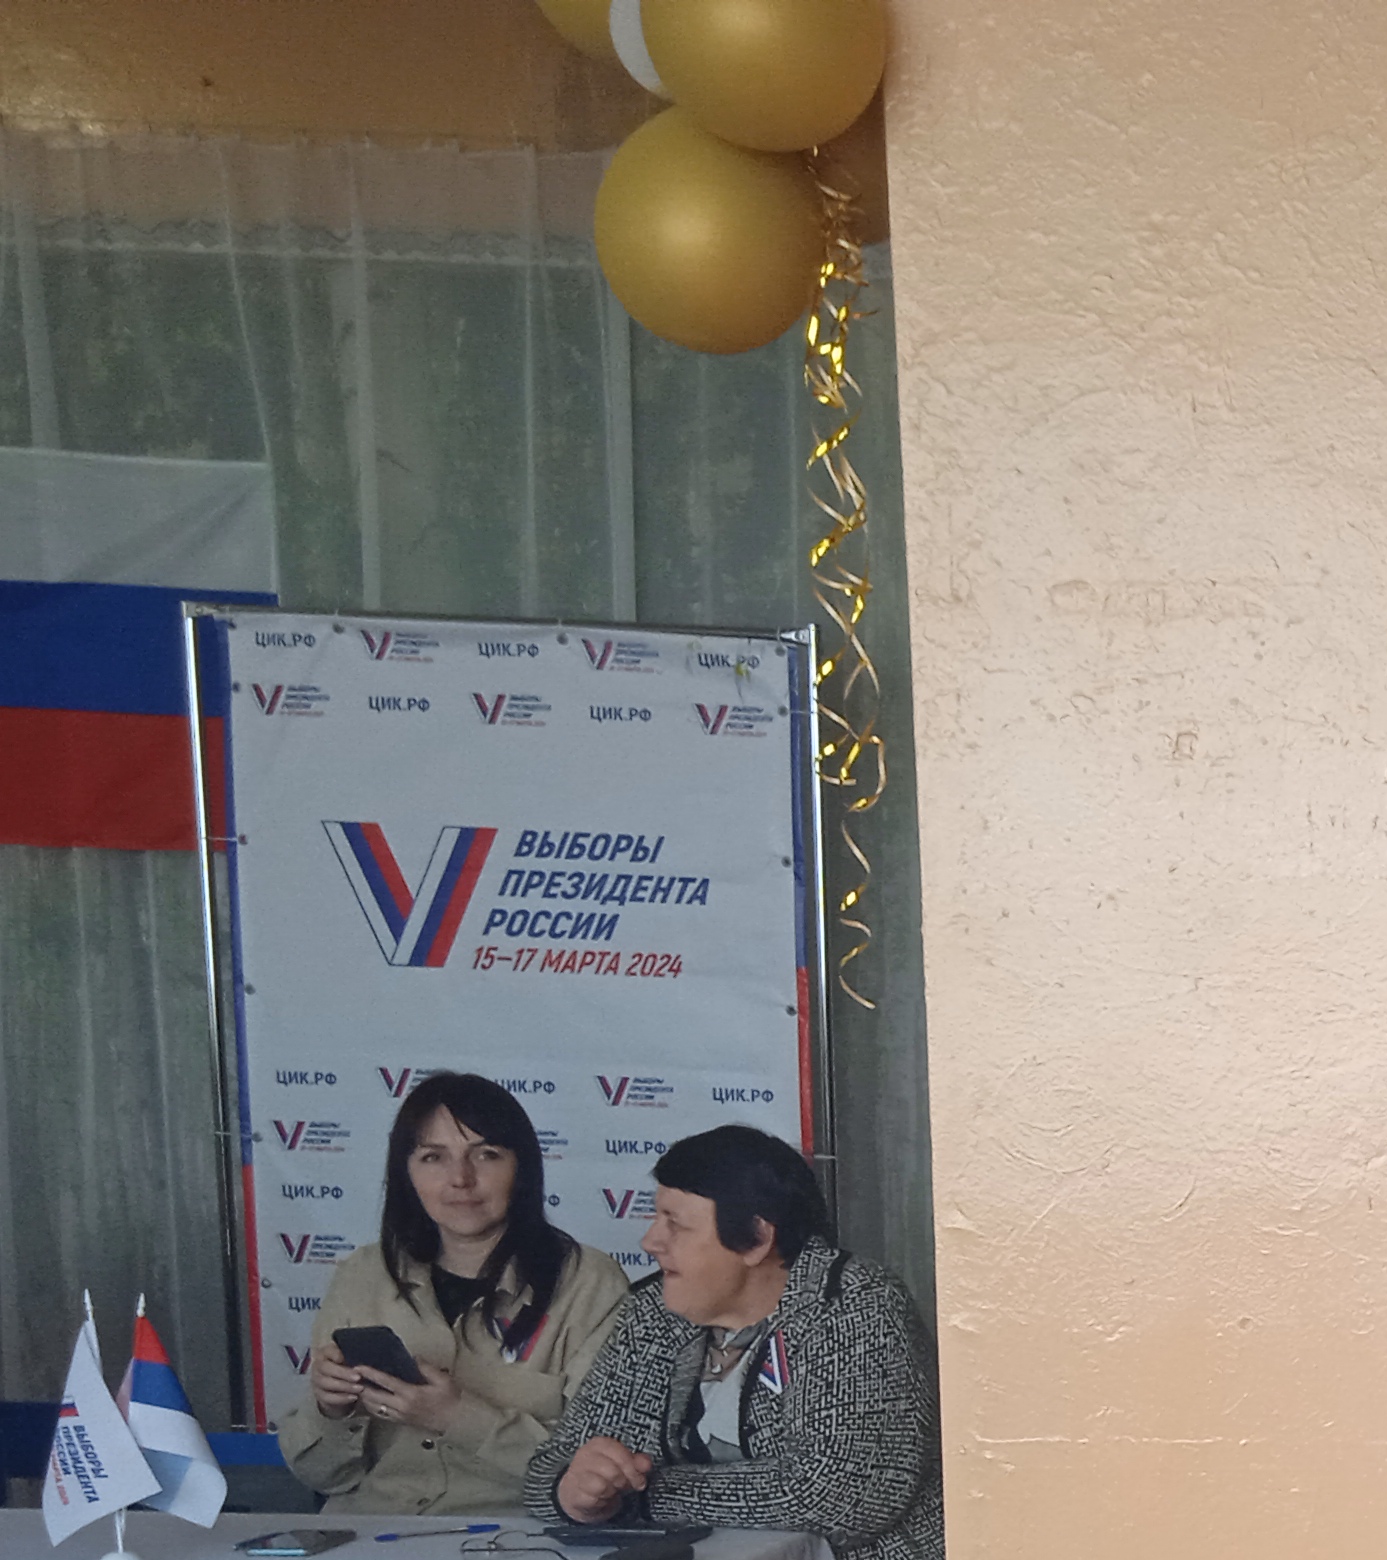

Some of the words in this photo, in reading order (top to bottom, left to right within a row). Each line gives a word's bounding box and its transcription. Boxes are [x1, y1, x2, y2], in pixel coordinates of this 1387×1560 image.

[254, 631, 317, 648] ЦИК.РФ
[478, 642, 540, 658] ЦИК.РФ
[697, 652, 761, 669] ЦИК.РФ
[368, 695, 431, 713] ЦИК.РФ
[589, 704, 653, 722] ЦИК.РФ
[513, 829, 665, 864] ВЫБОРЫ
[497, 869, 711, 907] ПРЕЗИДЕНТА
[482, 908, 621, 941] РОССИИ
[539, 949, 622, 976] МАРТА
[624, 952, 684, 979] 2024
[276, 1070, 338, 1087] ЦИК.РФ
[712, 1087, 774, 1104] ЦИК.РФ
[605, 1139, 667, 1156] ЦИК.РФ
[281, 1183, 344, 1200] ЦИК.РФ
[288, 1296, 321, 1312] ЦИК
[73, 1424, 109, 1479] ВЫБОРЫ
[61, 1425, 100, 1503] ПРЕЗИДЕНТА
